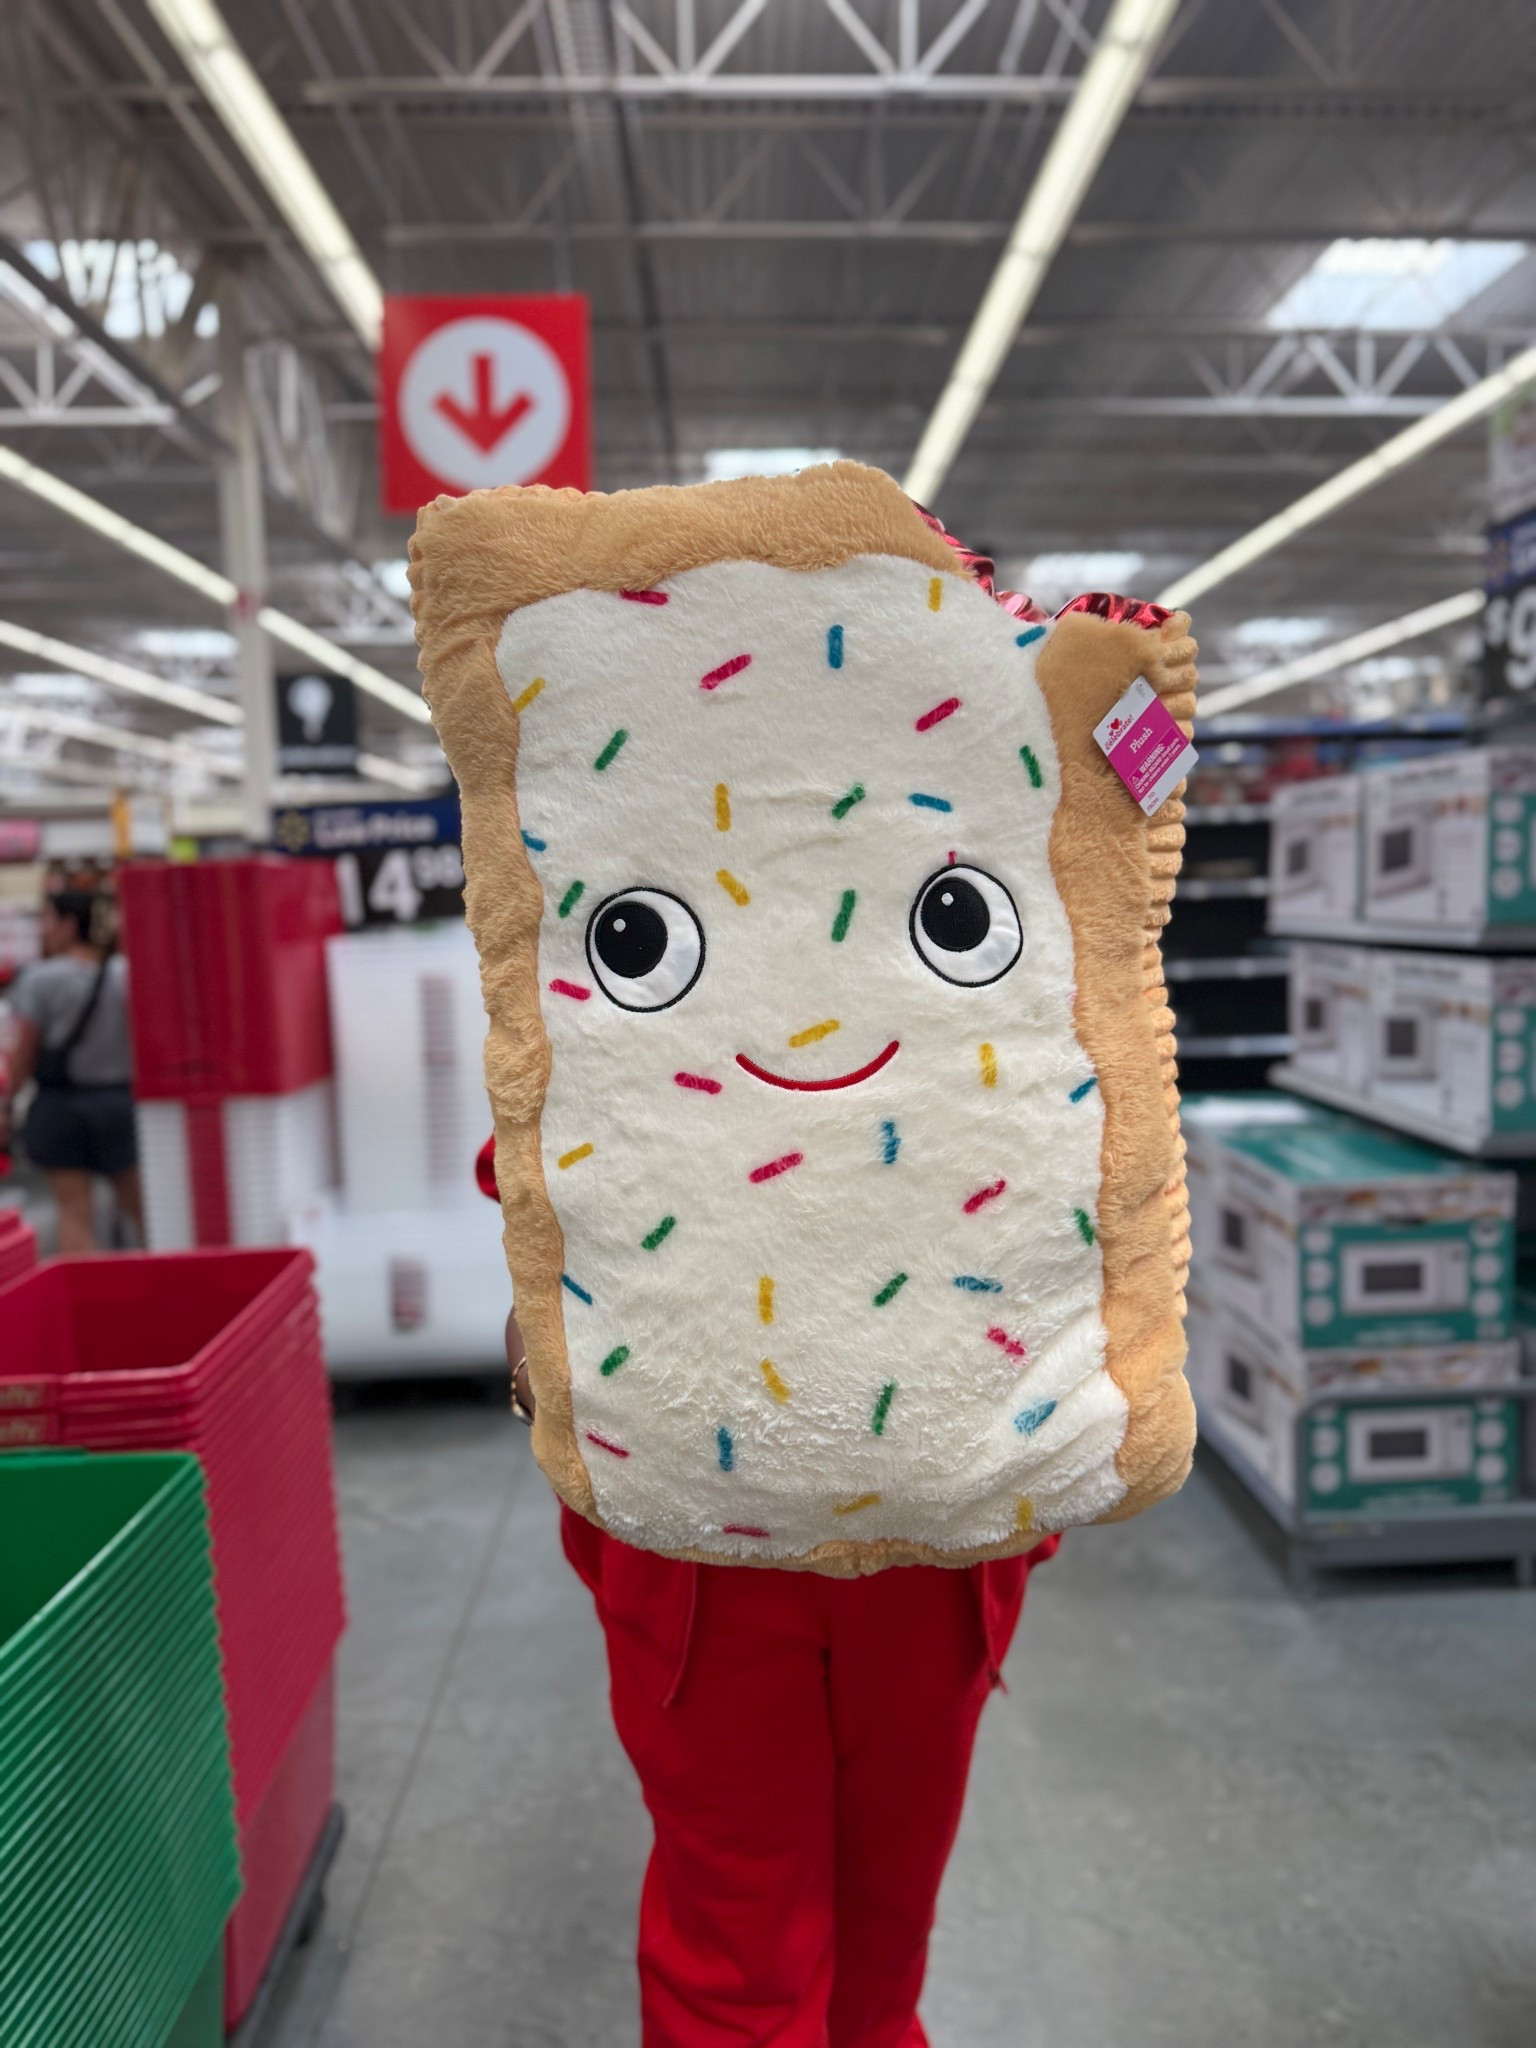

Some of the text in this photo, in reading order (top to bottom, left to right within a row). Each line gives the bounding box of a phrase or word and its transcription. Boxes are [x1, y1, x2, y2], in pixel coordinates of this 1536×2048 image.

[1105, 714, 1134, 750] celebrate!
[1129, 727, 1153, 754] Plush
[1139, 743, 1166, 774] WARNING:
[367, 811, 437, 844] Price
